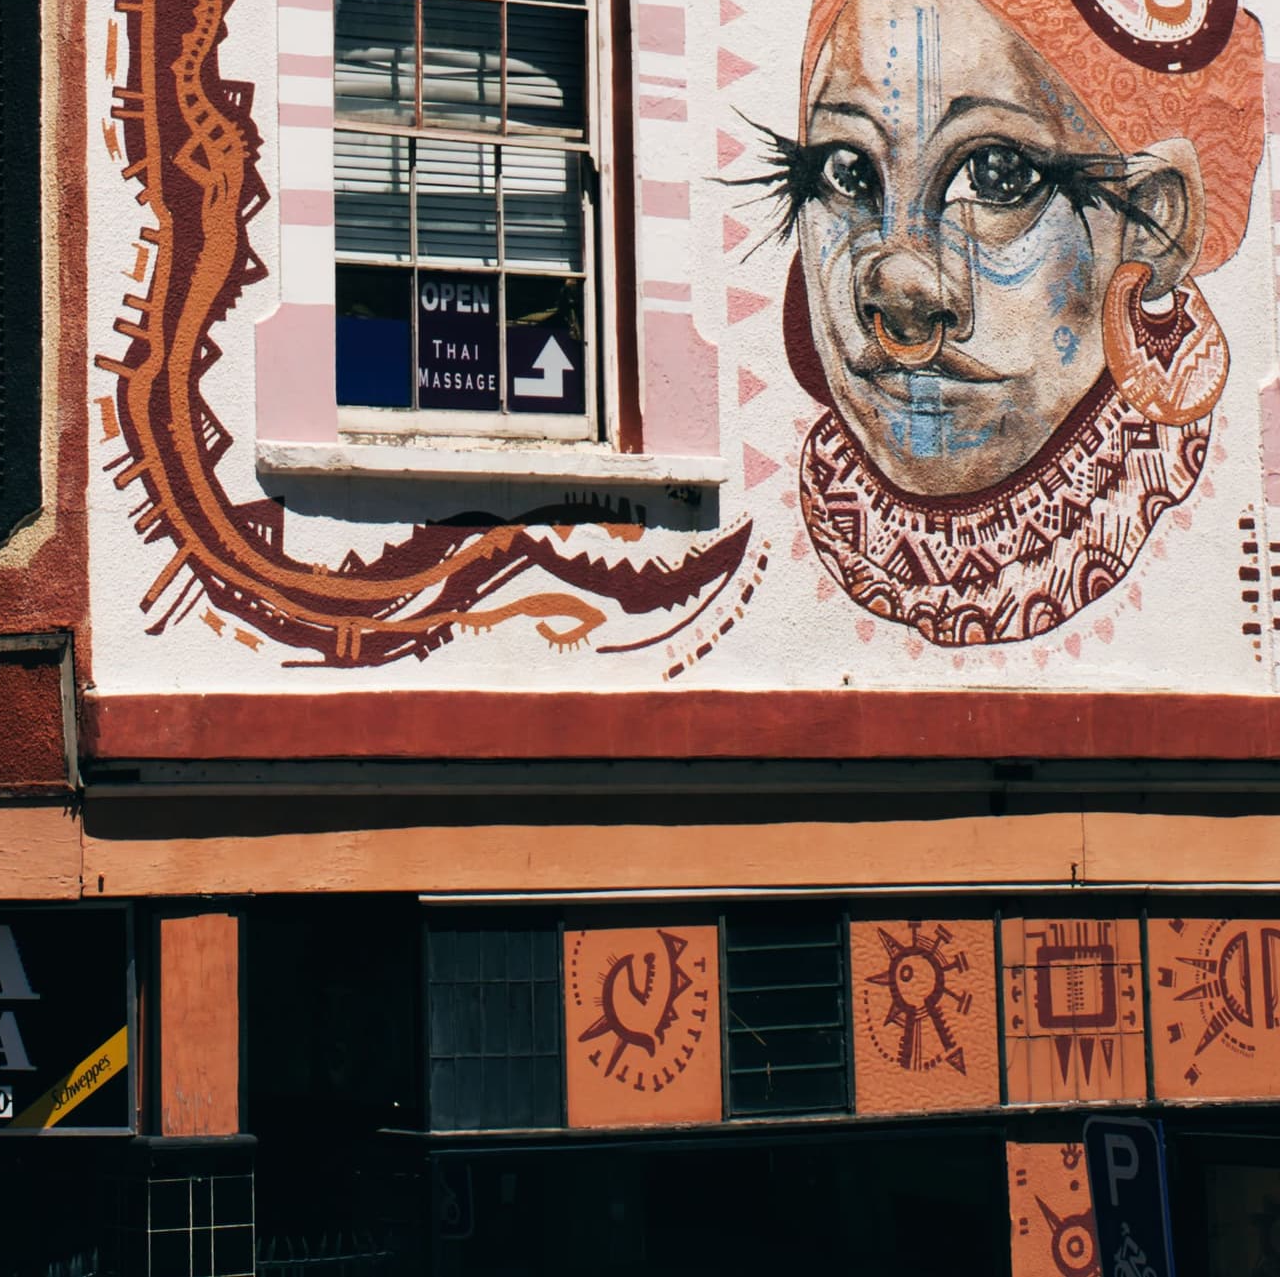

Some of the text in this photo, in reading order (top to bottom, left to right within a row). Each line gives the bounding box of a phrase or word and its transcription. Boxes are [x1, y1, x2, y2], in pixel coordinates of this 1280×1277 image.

[421, 282, 490, 314] OPEN
[432, 339, 479, 361] THAI
[418, 366, 496, 391] MASSAGE
[51, 1053, 111, 1111] Schweppes
[1104, 1133, 1139, 1206] P
